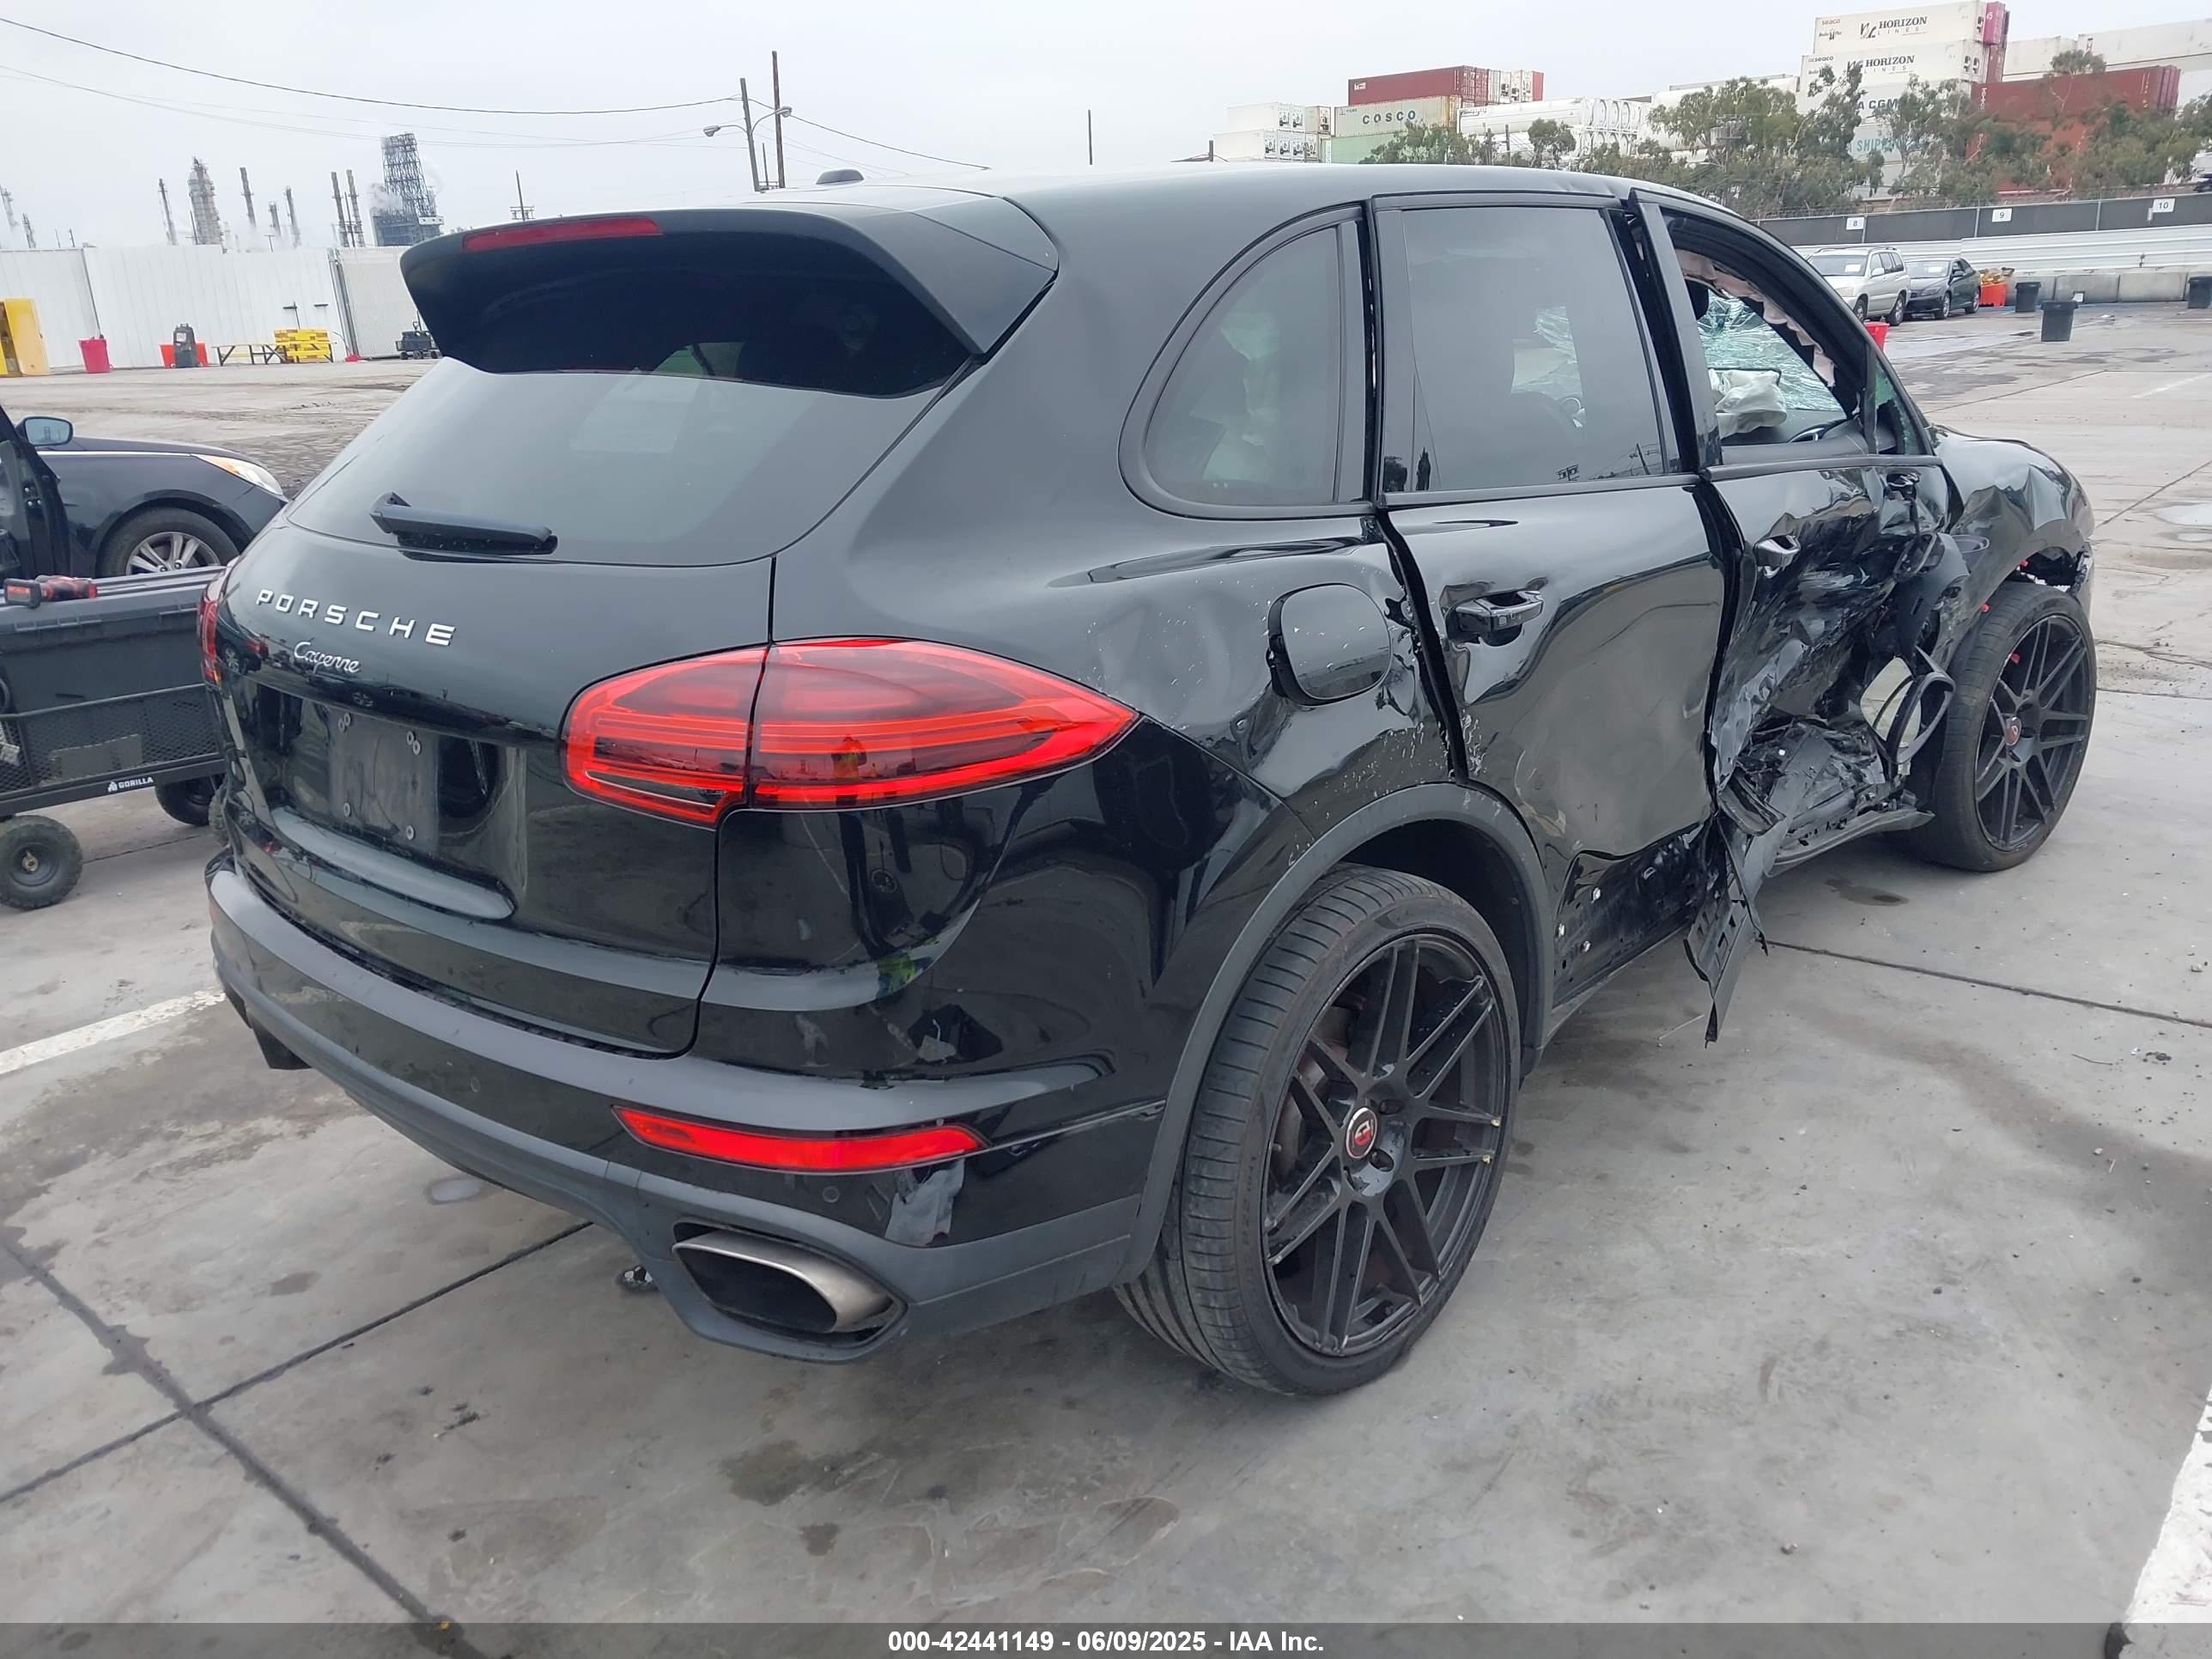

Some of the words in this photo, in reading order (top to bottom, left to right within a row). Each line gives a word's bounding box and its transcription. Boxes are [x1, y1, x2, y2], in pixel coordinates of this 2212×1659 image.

[1878, 15, 1928, 29] HORIZON
[1877, 27, 1920, 35] LINES
[1865, 55, 1915, 68] HORIZON
[1864, 65, 1907, 74] LINES
[1362, 110, 1416, 125] COSCO
[2158, 201, 2170, 210] 10
[256, 589, 456, 647] PORSCHE
[294, 641, 361, 674] Cayenne
[118, 777, 154, 788] GORILLA
